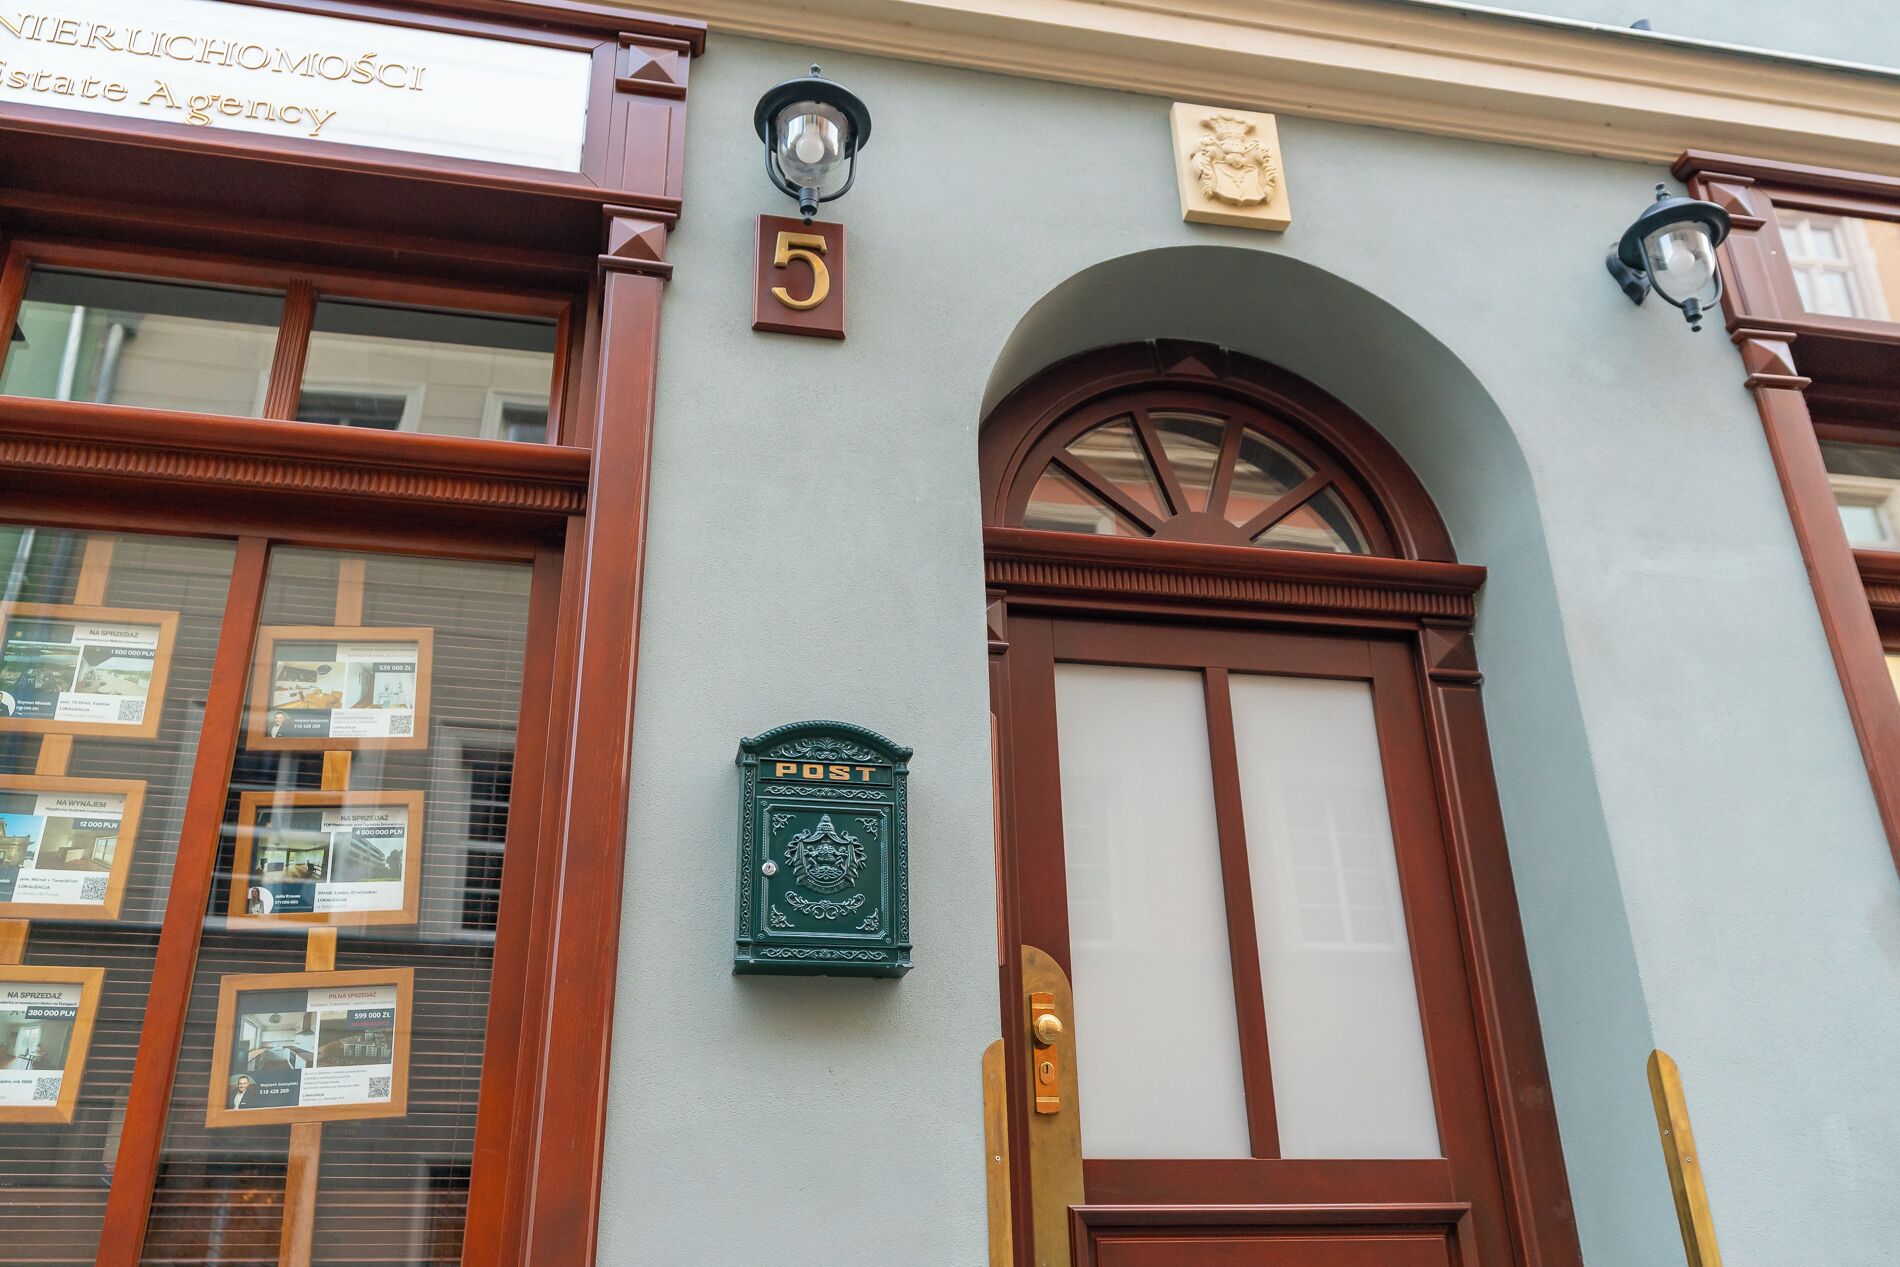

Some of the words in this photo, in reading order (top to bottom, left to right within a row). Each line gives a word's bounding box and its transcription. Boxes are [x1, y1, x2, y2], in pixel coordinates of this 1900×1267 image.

[139, 78, 337, 137] Agency
[771, 231, 830, 310] 5
[775, 762, 876, 782] POST
[68, 800, 107, 808] WYNAJEM
[103, 821, 118, 829] PLN
[19, 991, 63, 999] SPRZEDAŻ
[354, 1012, 368, 1020] 599
